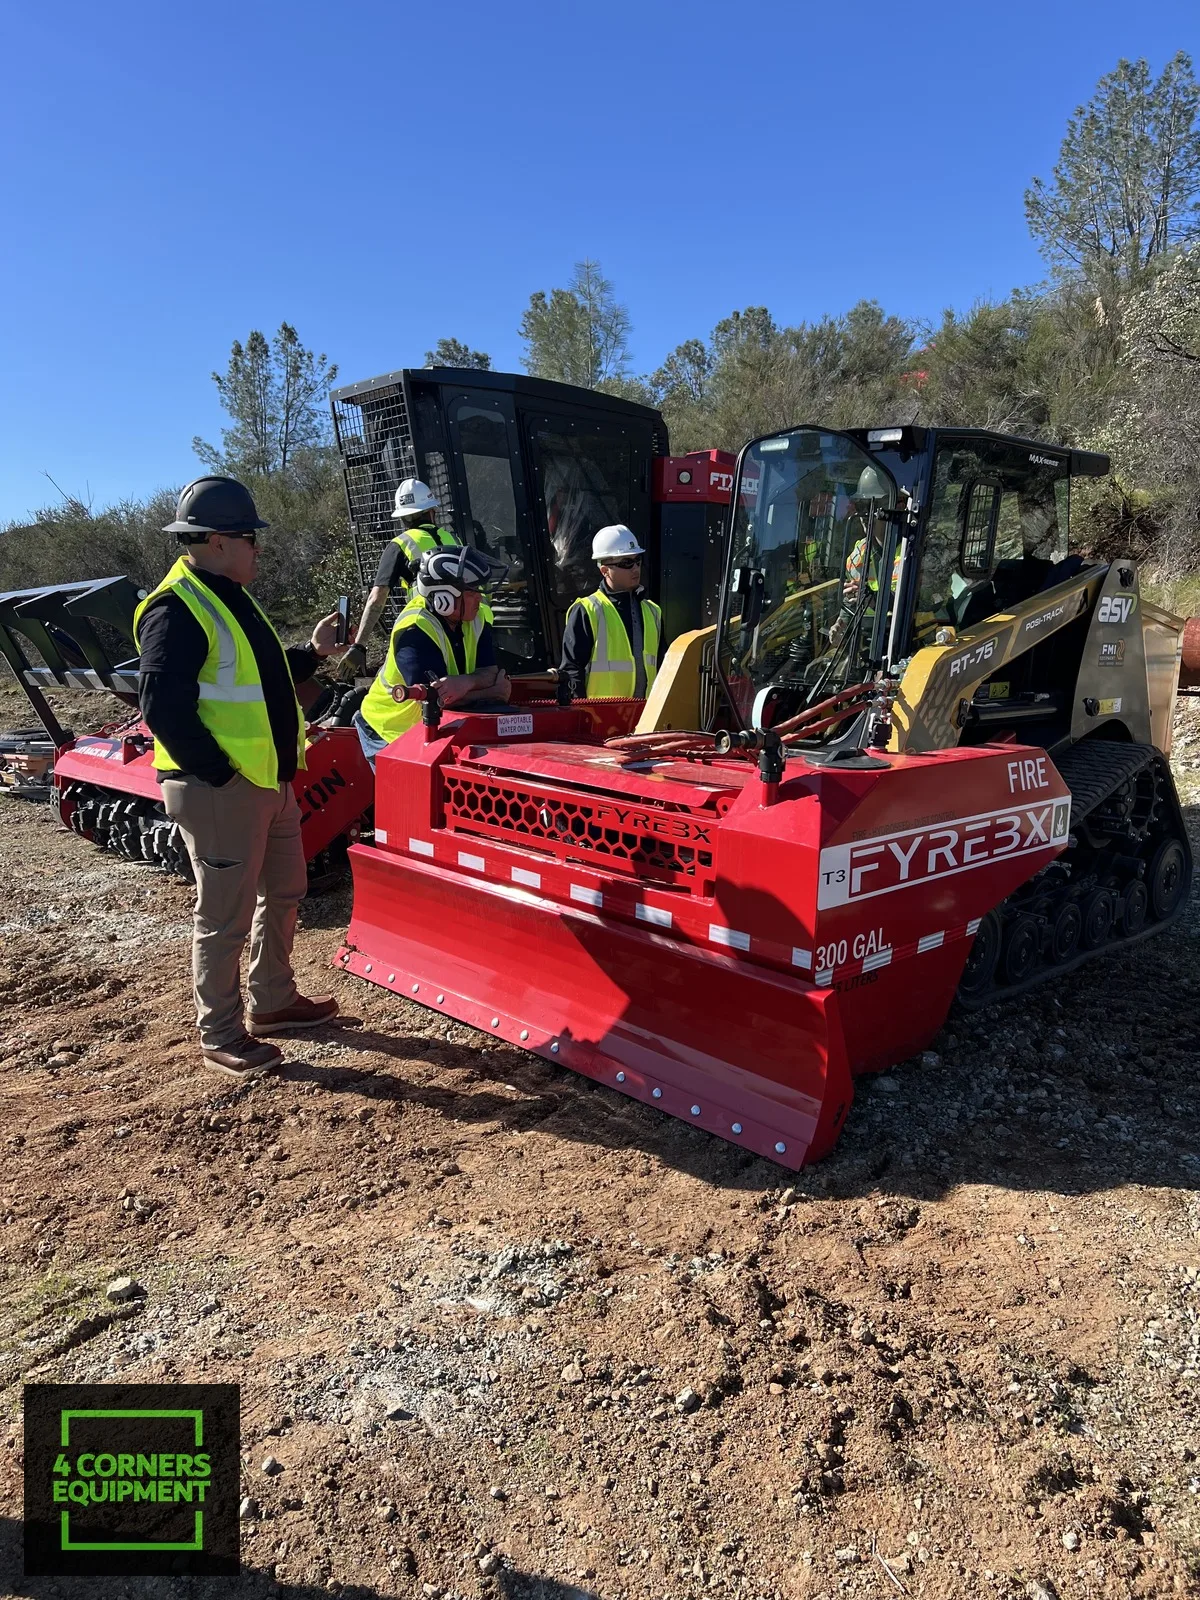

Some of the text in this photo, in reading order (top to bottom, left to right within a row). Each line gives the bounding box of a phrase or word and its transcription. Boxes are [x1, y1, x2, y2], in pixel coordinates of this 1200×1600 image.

[1025, 606, 1064, 631] POSI-TRACK
[950, 641, 994, 677] RT-75
[1102, 644, 1117, 655] FMI
[498, 716, 532, 725] NON-POTABLE
[1007, 757, 1049, 793] FIRE
[822, 869, 846, 885] T3
[815, 927, 892, 971] 300 GAL.
